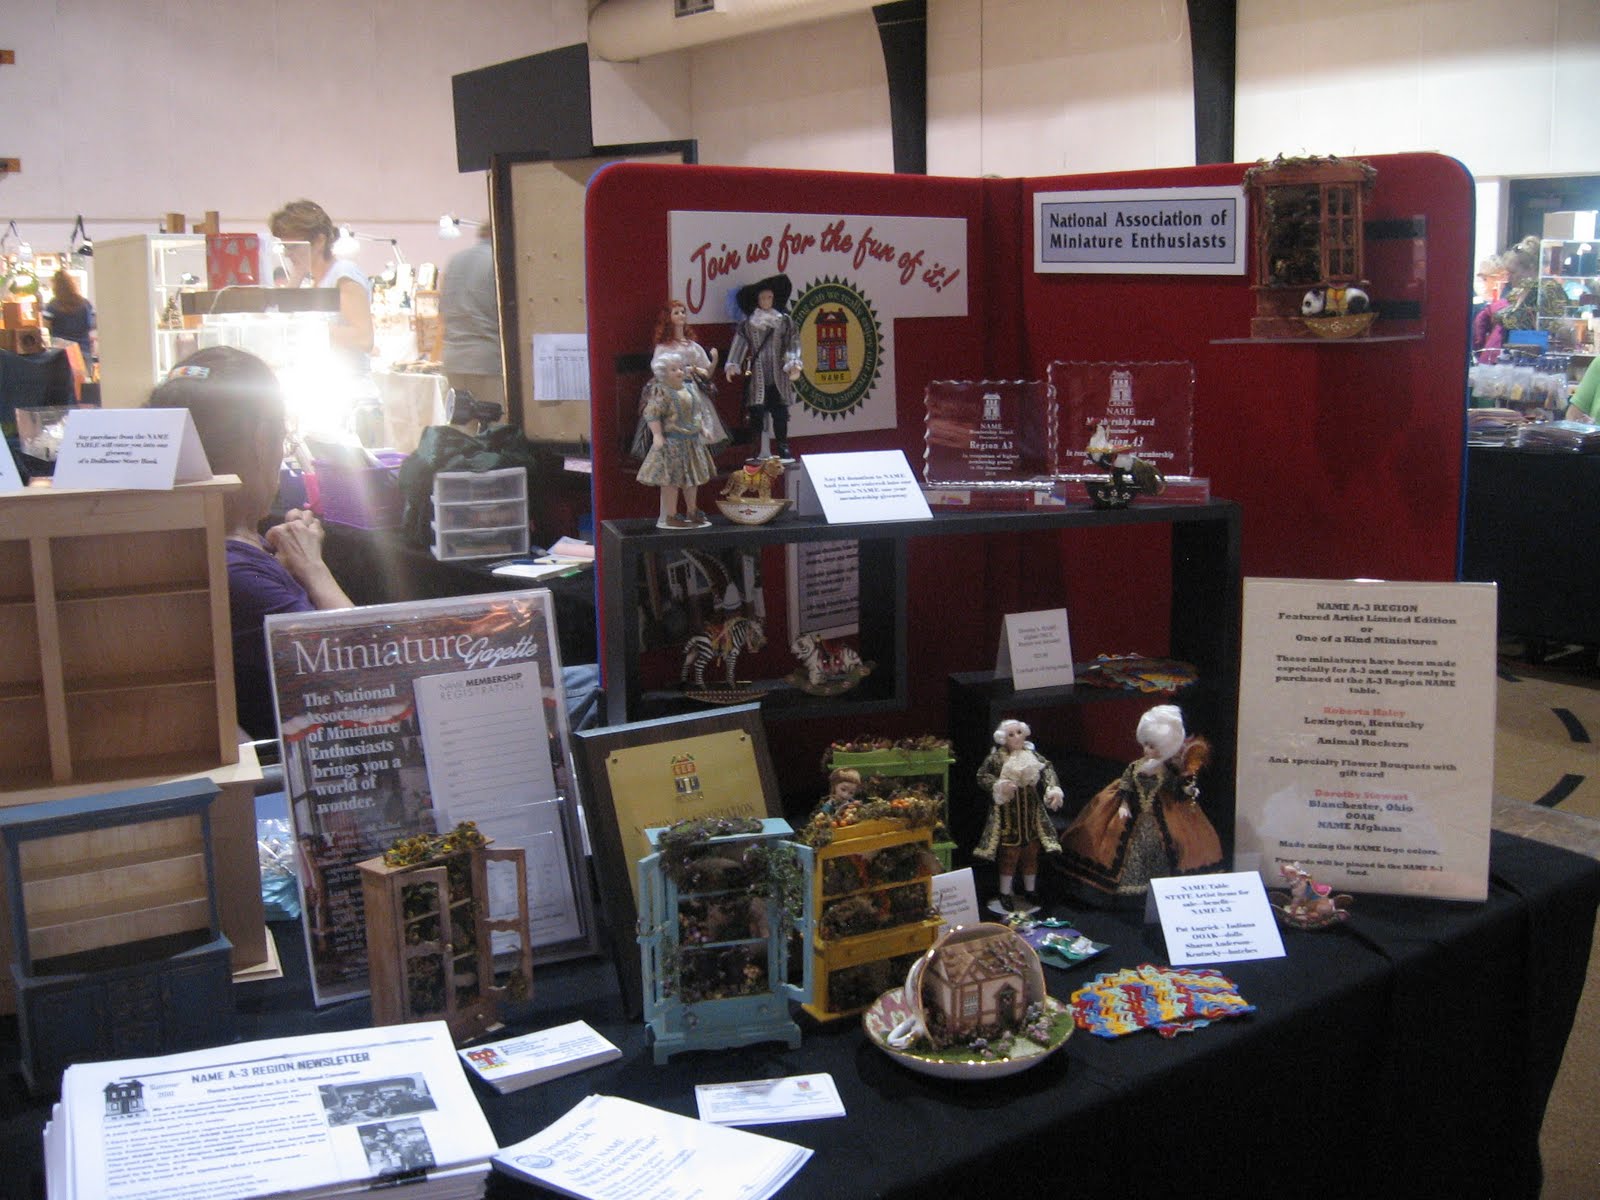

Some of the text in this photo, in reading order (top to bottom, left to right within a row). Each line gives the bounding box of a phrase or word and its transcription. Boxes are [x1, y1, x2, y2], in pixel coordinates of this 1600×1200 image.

[1050, 209, 1227, 227] National Association of
[1051, 233, 1226, 248] Miniature Enthusiasts
[686, 219, 960, 314] Join us for the fun of it!
[821, 373, 845, 381] NAME
[970, 441, 1013, 451] Region A3
[1317, 602, 1418, 613] NAME A-3 REGION
[1278, 612, 1456, 624] Featured Artist Limited Edition
[1296, 634, 1318, 642] One
[1321, 635, 1333, 643] of
[1344, 636, 1371, 644] Kind
[1374, 637, 1438, 645] Miniatures
[292, 633, 538, 675] Miniature Gazette
[1276, 655, 1456, 667] These miniatures have been made
[1277, 665, 1330, 674] especially
[1332, 666, 1347, 674] for
[1392, 670, 1416, 678] may
[1417, 670, 1440, 678] only
[465, 672, 523, 688] MEMBERSHIP
[1275, 675, 1331, 685] purchased
[1347, 676, 1364, 684] the
[1366, 677, 1382, 685] A-3
[1384, 678, 1423, 688] Region
[1425, 679, 1456, 687] NAME
[303, 683, 397, 708] The National
[1349, 687, 1380, 695] table.
[304, 703, 386, 725] Association
[1304, 717, 1424, 730] Lexington, Kentucky
[308, 722, 400, 743] of Miniature
[1317, 737, 1409, 748] Animal Rockers
[309, 739, 395, 761] Enthusiasts
[312, 757, 402, 779] brings you a
[1269, 756, 1456, 771] And specialty Flower Bouquets with
[1339, 769, 1357, 778] gift
[315, 774, 377, 796] world of
[317, 795, 377, 815] wonder.
[1309, 800, 1413, 812] Blanchester, Ohio
[1346, 812, 1375, 820] OOAK
[1318, 821, 1402, 833] NAME Afghans
[1279, 840, 1305, 849] Made
[1308, 842, 1333, 851] using
[1337, 842, 1351, 850] the
[1354, 844, 1381, 852] NAME
[1383, 845, 1404, 854] logo
[191, 1052, 370, 1083] NAME A-3 REGION NEWSLETTER
